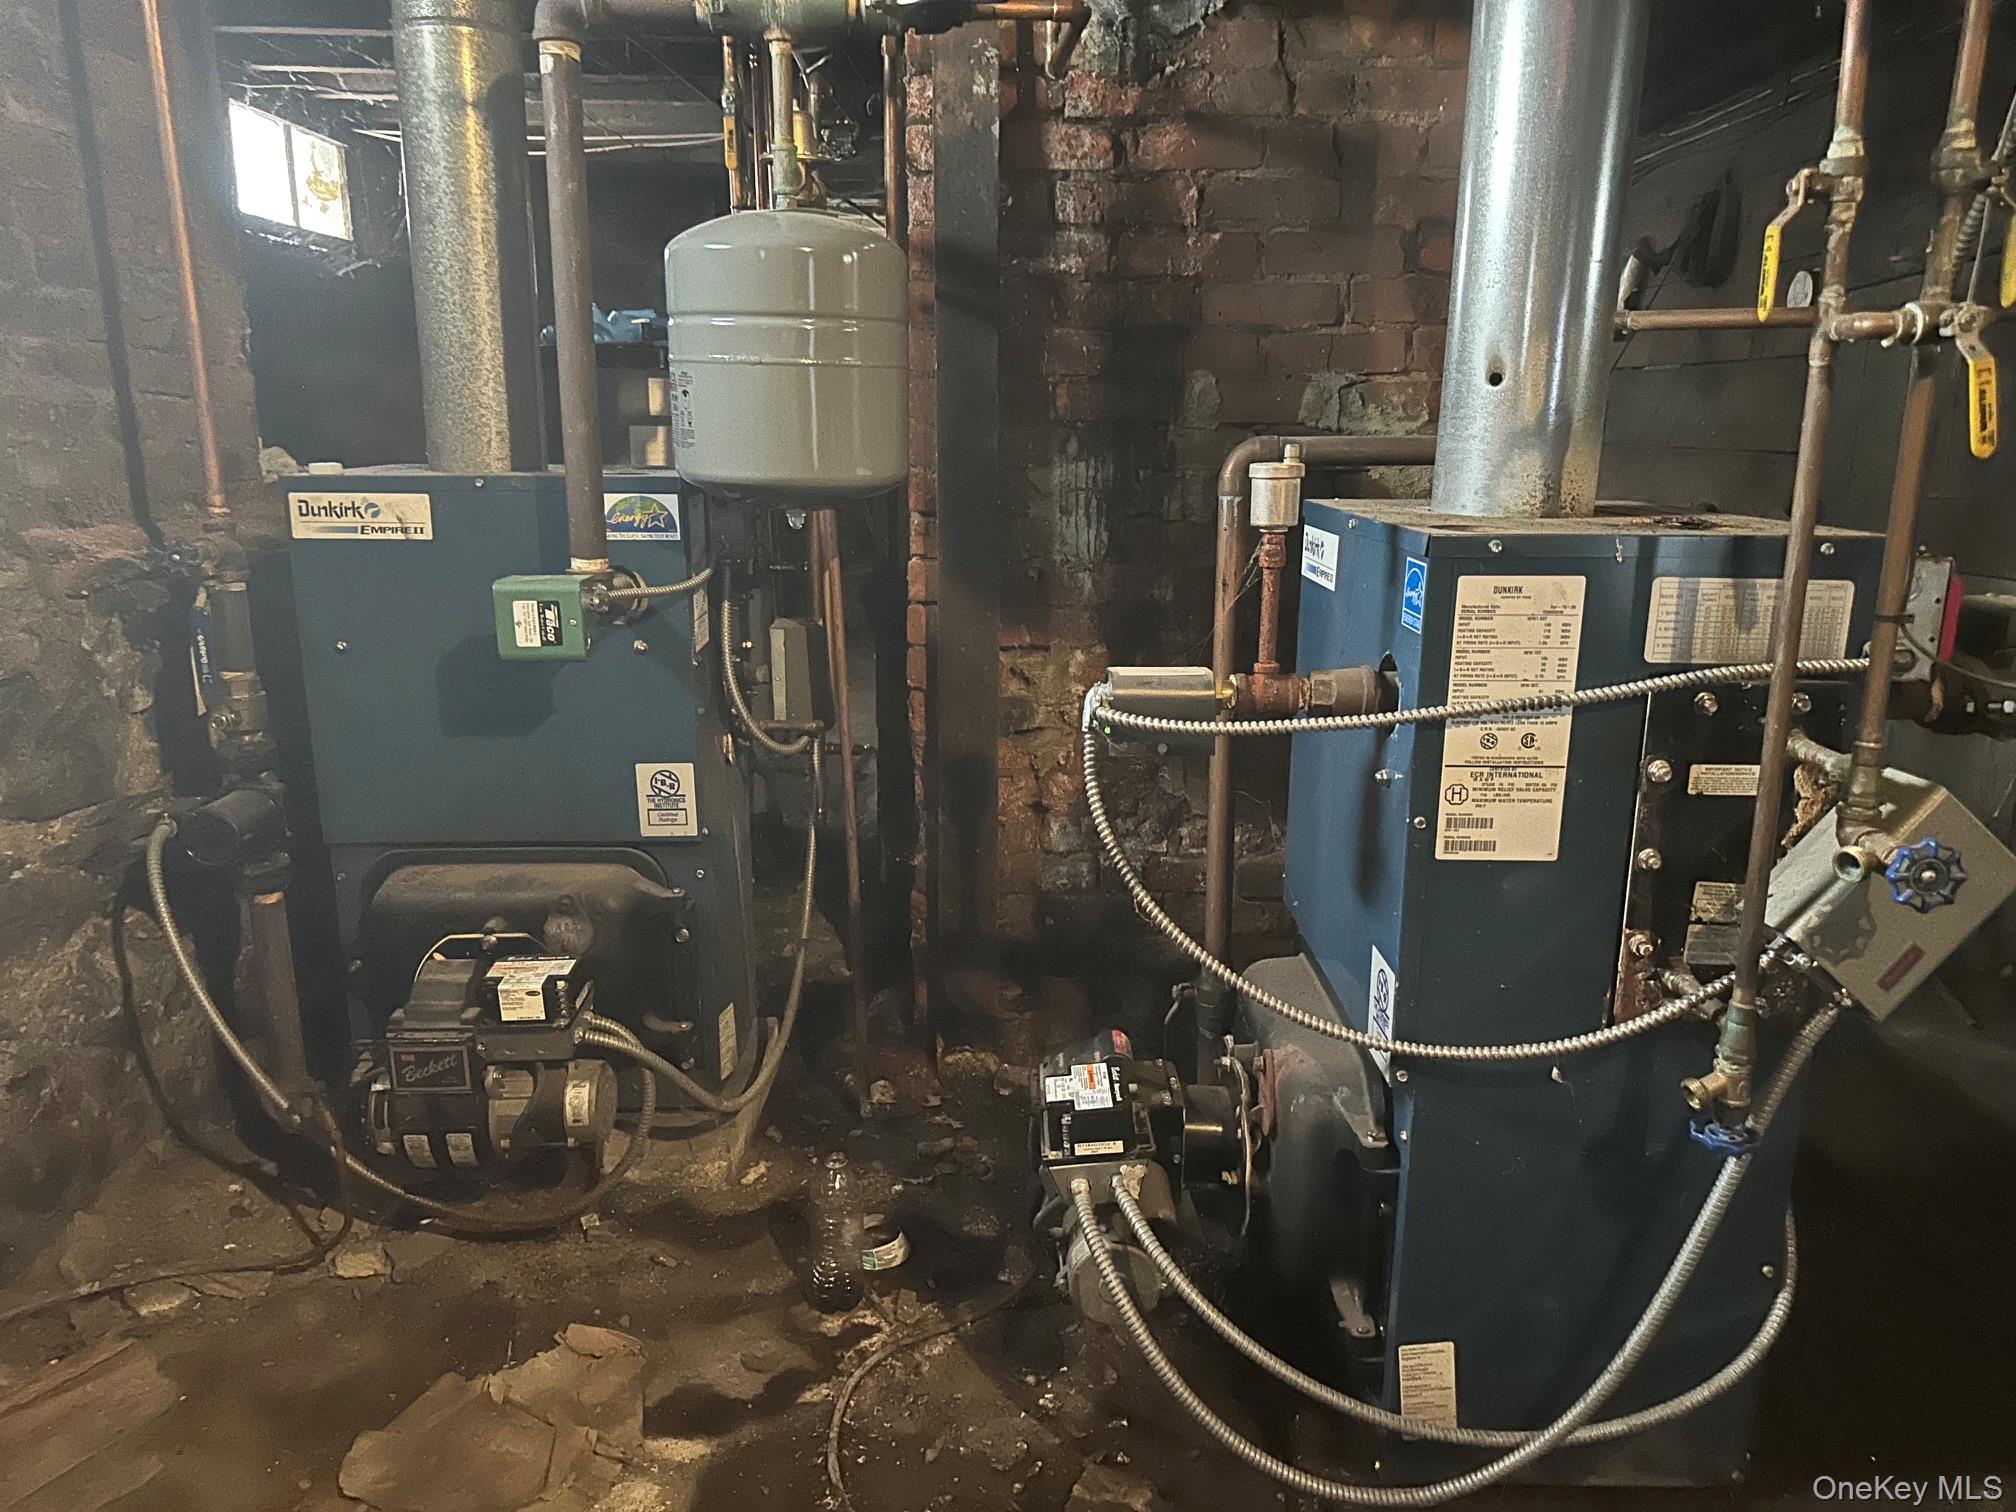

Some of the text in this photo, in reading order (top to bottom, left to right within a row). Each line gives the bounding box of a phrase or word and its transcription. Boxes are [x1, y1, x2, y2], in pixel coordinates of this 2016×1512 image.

[298, 499, 364, 520] Dunkirk
[360, 525, 411, 535] EMPIRE
[1493, 586, 1523, 594] DUNKIRK
[402, 1053, 458, 1082] Beckett
